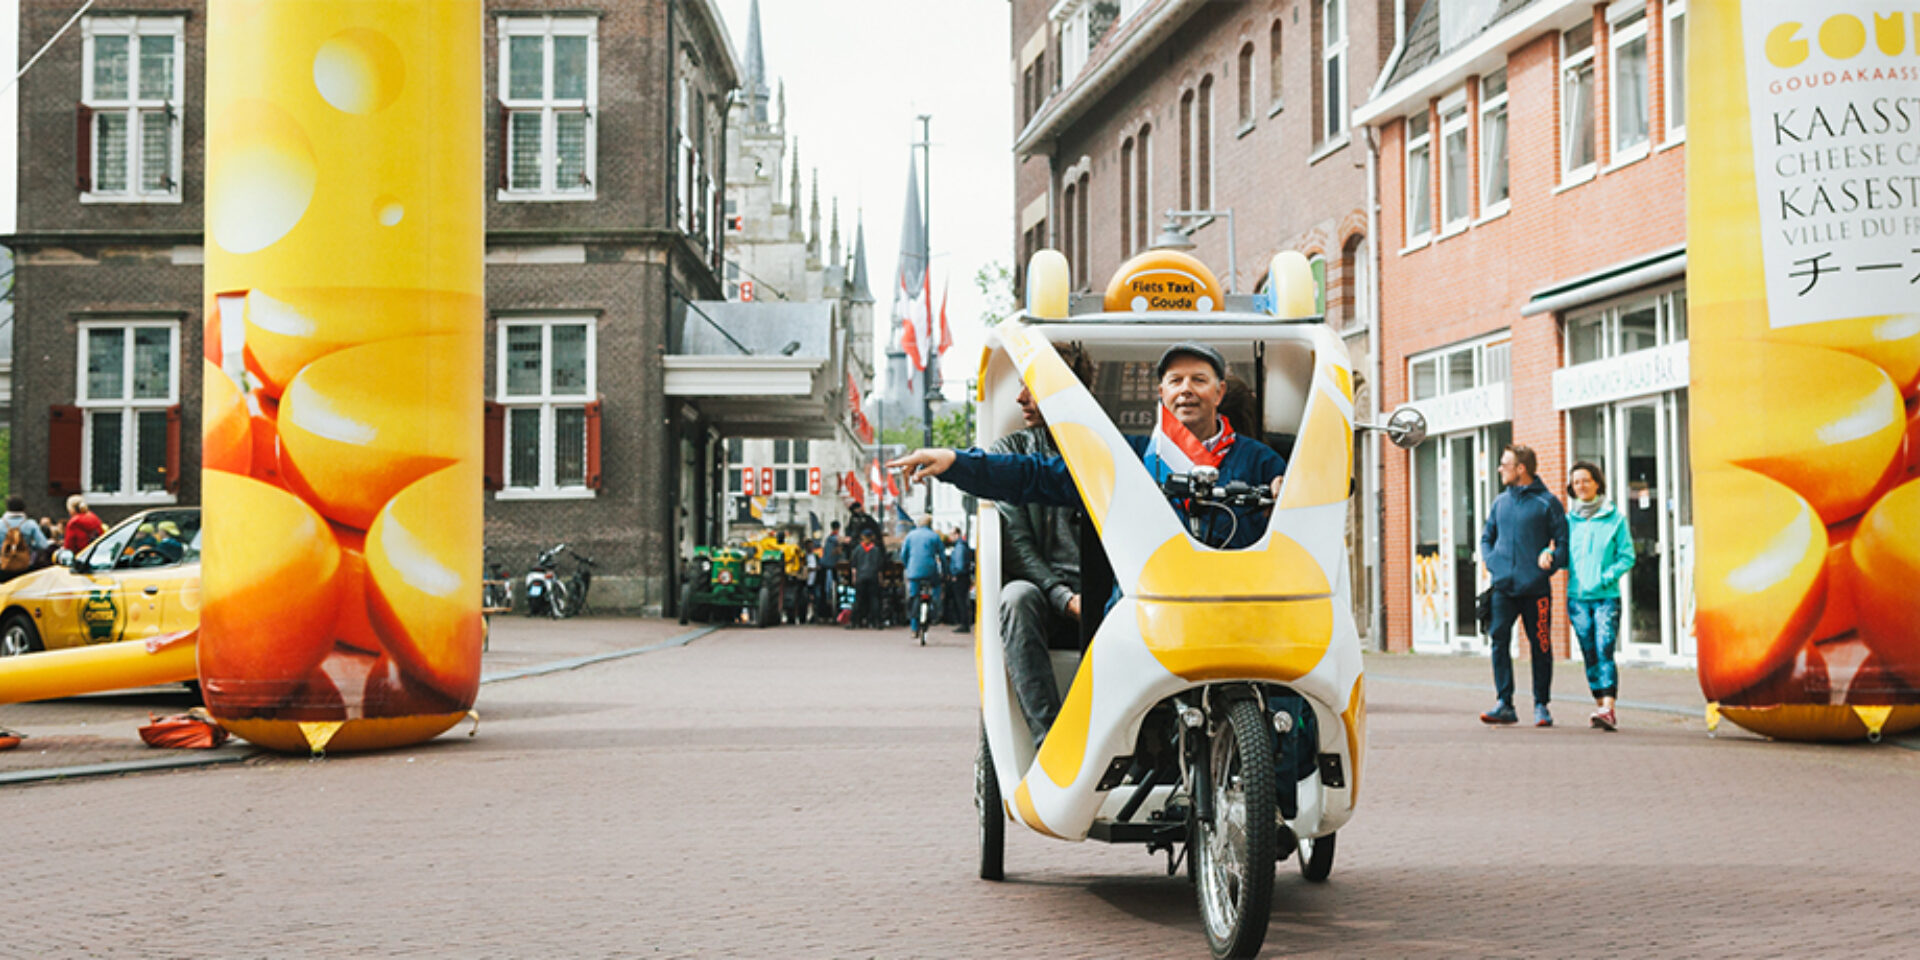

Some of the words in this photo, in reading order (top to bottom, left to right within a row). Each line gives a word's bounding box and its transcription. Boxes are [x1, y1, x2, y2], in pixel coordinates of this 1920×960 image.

[1765, 11, 1920, 69] GOU
[1775, 144, 1889, 178] CHEESE
[1782, 219, 1852, 246] VILLE
[1861, 216, 1896, 238] DU
[1132, 281, 1164, 293] Fiets
[1167, 282, 1195, 294] Taxi
[1788, 248, 1920, 297] チー
[1151, 296, 1192, 308] Gouda
